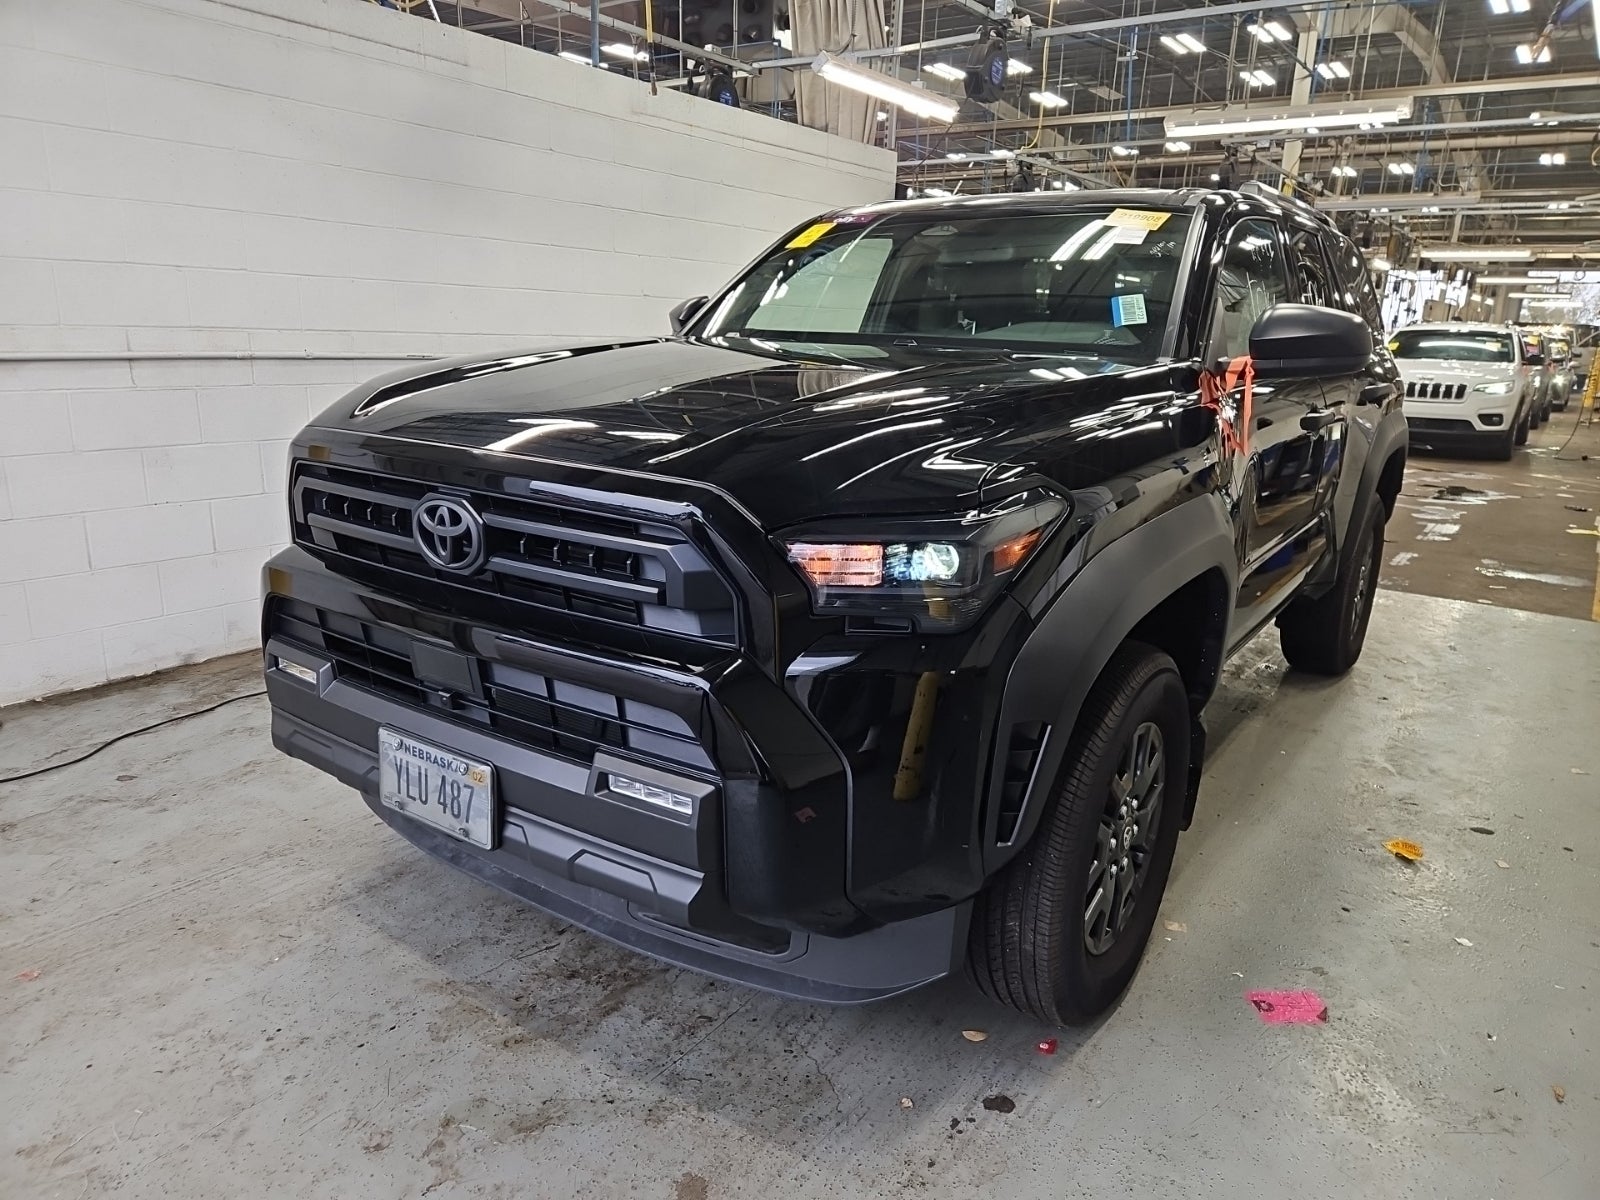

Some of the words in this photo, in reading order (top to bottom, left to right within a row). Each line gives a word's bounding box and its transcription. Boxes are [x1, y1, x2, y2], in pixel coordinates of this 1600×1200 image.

[394, 755, 428, 805] YLU
[438, 774, 475, 824] 487
[472, 771, 483, 783] 02
